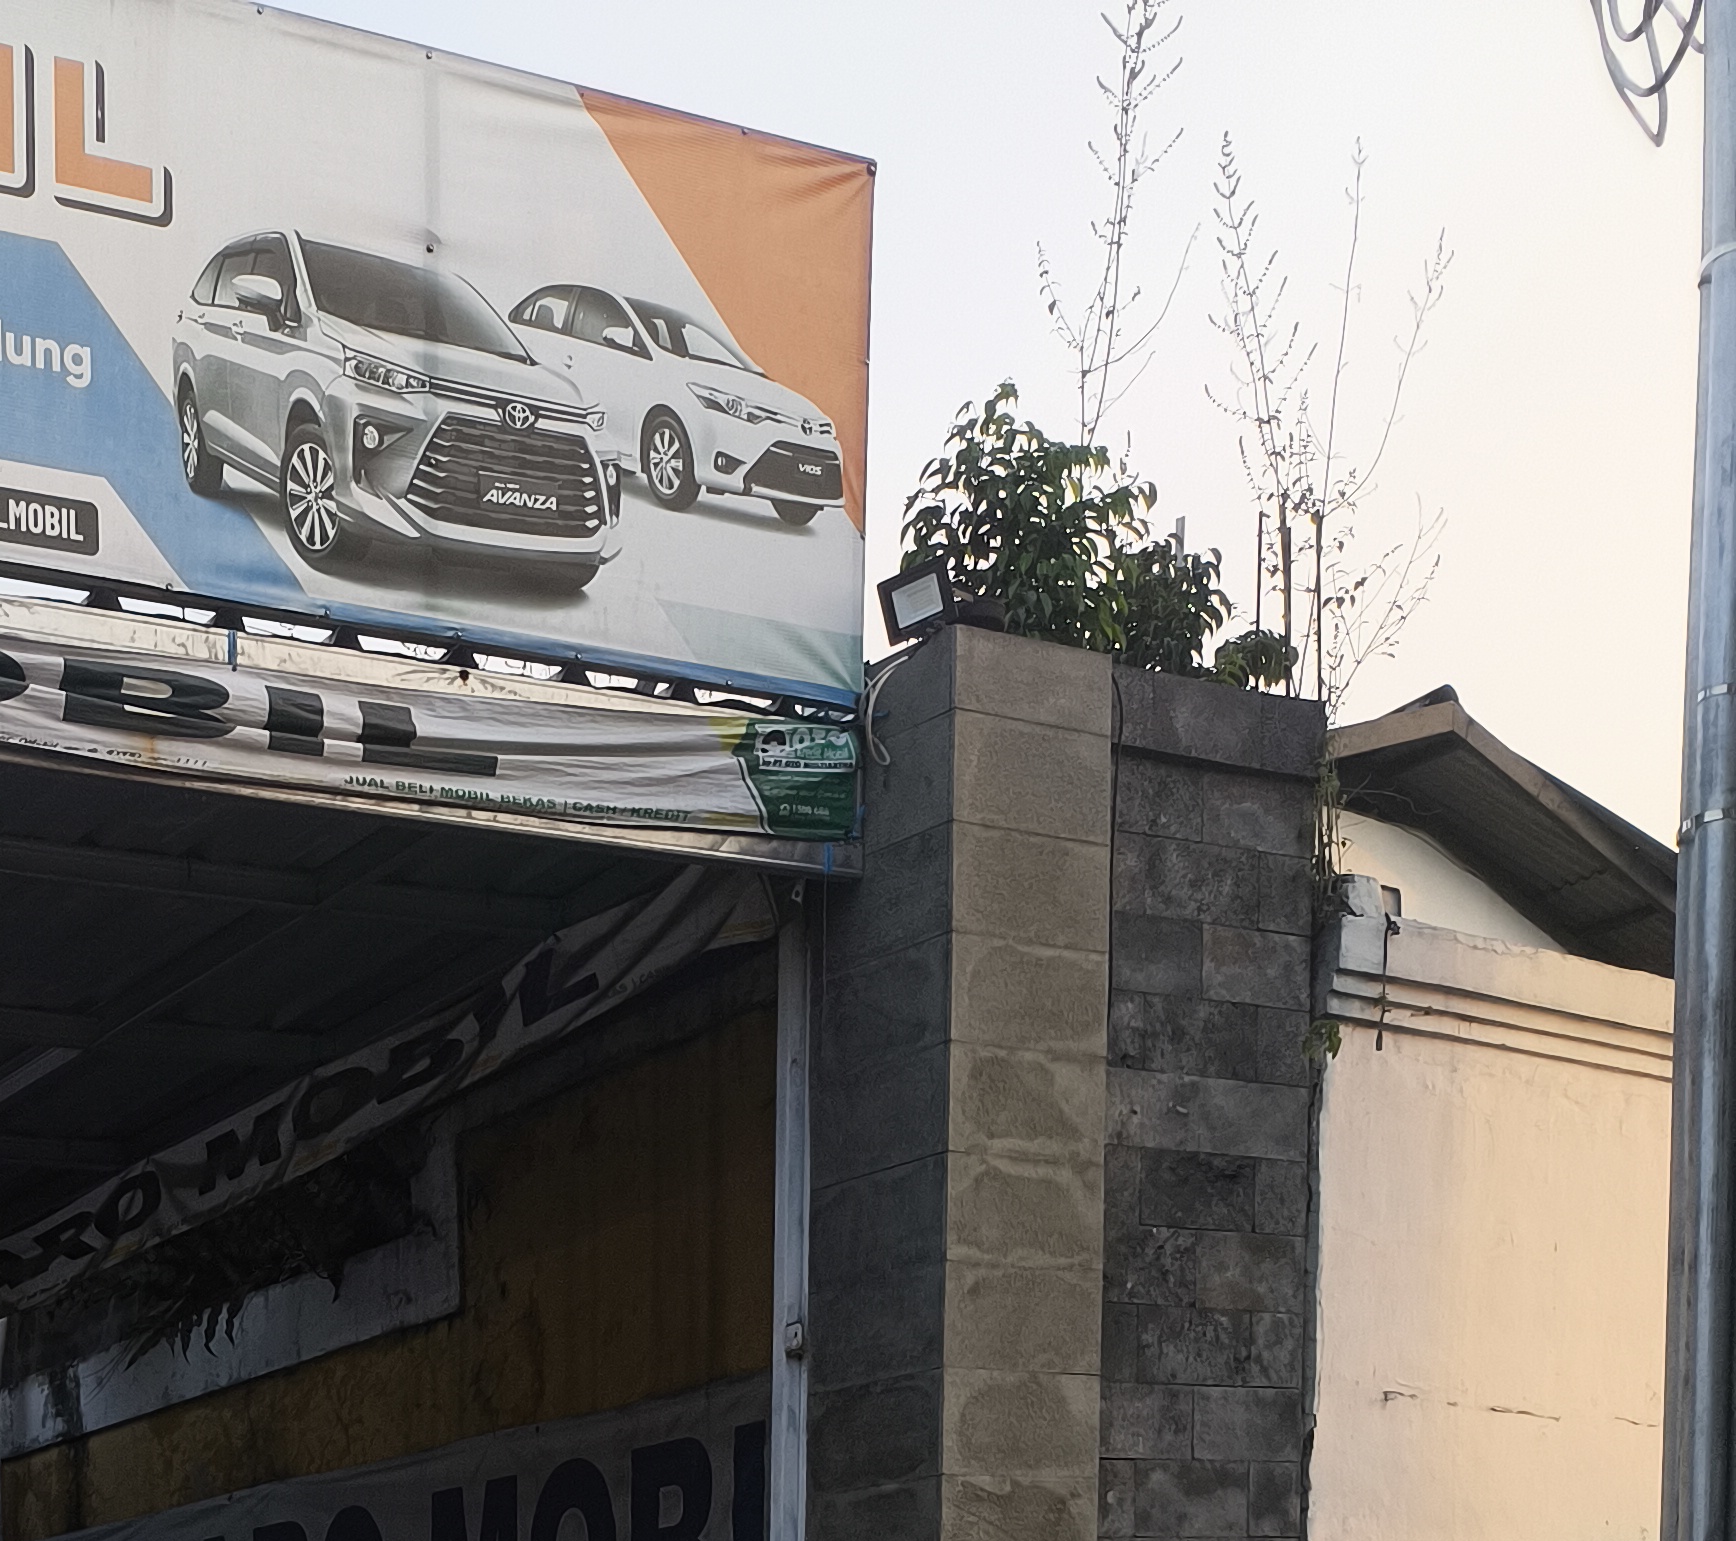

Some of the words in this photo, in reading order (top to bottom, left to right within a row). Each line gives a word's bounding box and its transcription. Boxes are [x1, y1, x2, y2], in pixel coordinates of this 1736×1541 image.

[797, 463, 823, 476] VIOS
[482, 487, 558, 512] AVANZA
[344, 775, 390, 791] JUAL
[439, 786, 495, 803] MOBIL
